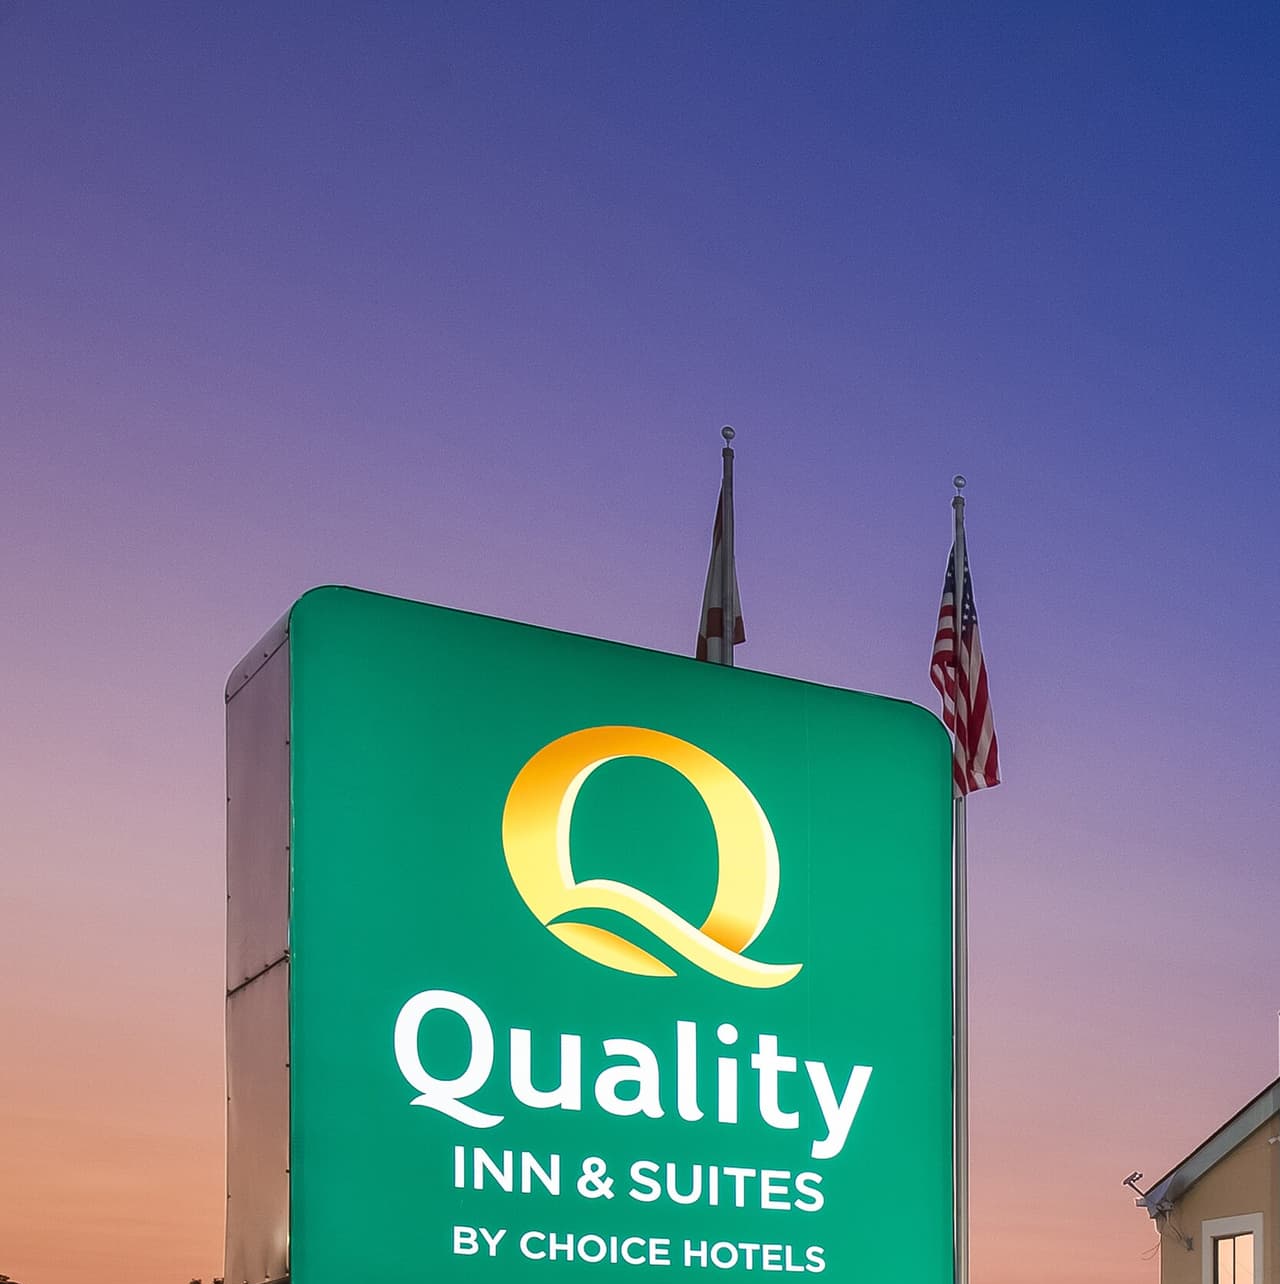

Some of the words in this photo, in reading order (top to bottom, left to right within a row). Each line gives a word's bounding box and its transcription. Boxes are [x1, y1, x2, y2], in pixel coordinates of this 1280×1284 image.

[502, 726, 804, 989] Q
[394, 989, 873, 1160] Quality
[454, 1146, 562, 1196] INN
[577, 1157, 615, 1200] &
[629, 1161, 825, 1212] SUITES
[454, 1227, 507, 1256] BY
[520, 1231, 671, 1266] CHOICE
[685, 1240, 827, 1273] HOTELS
